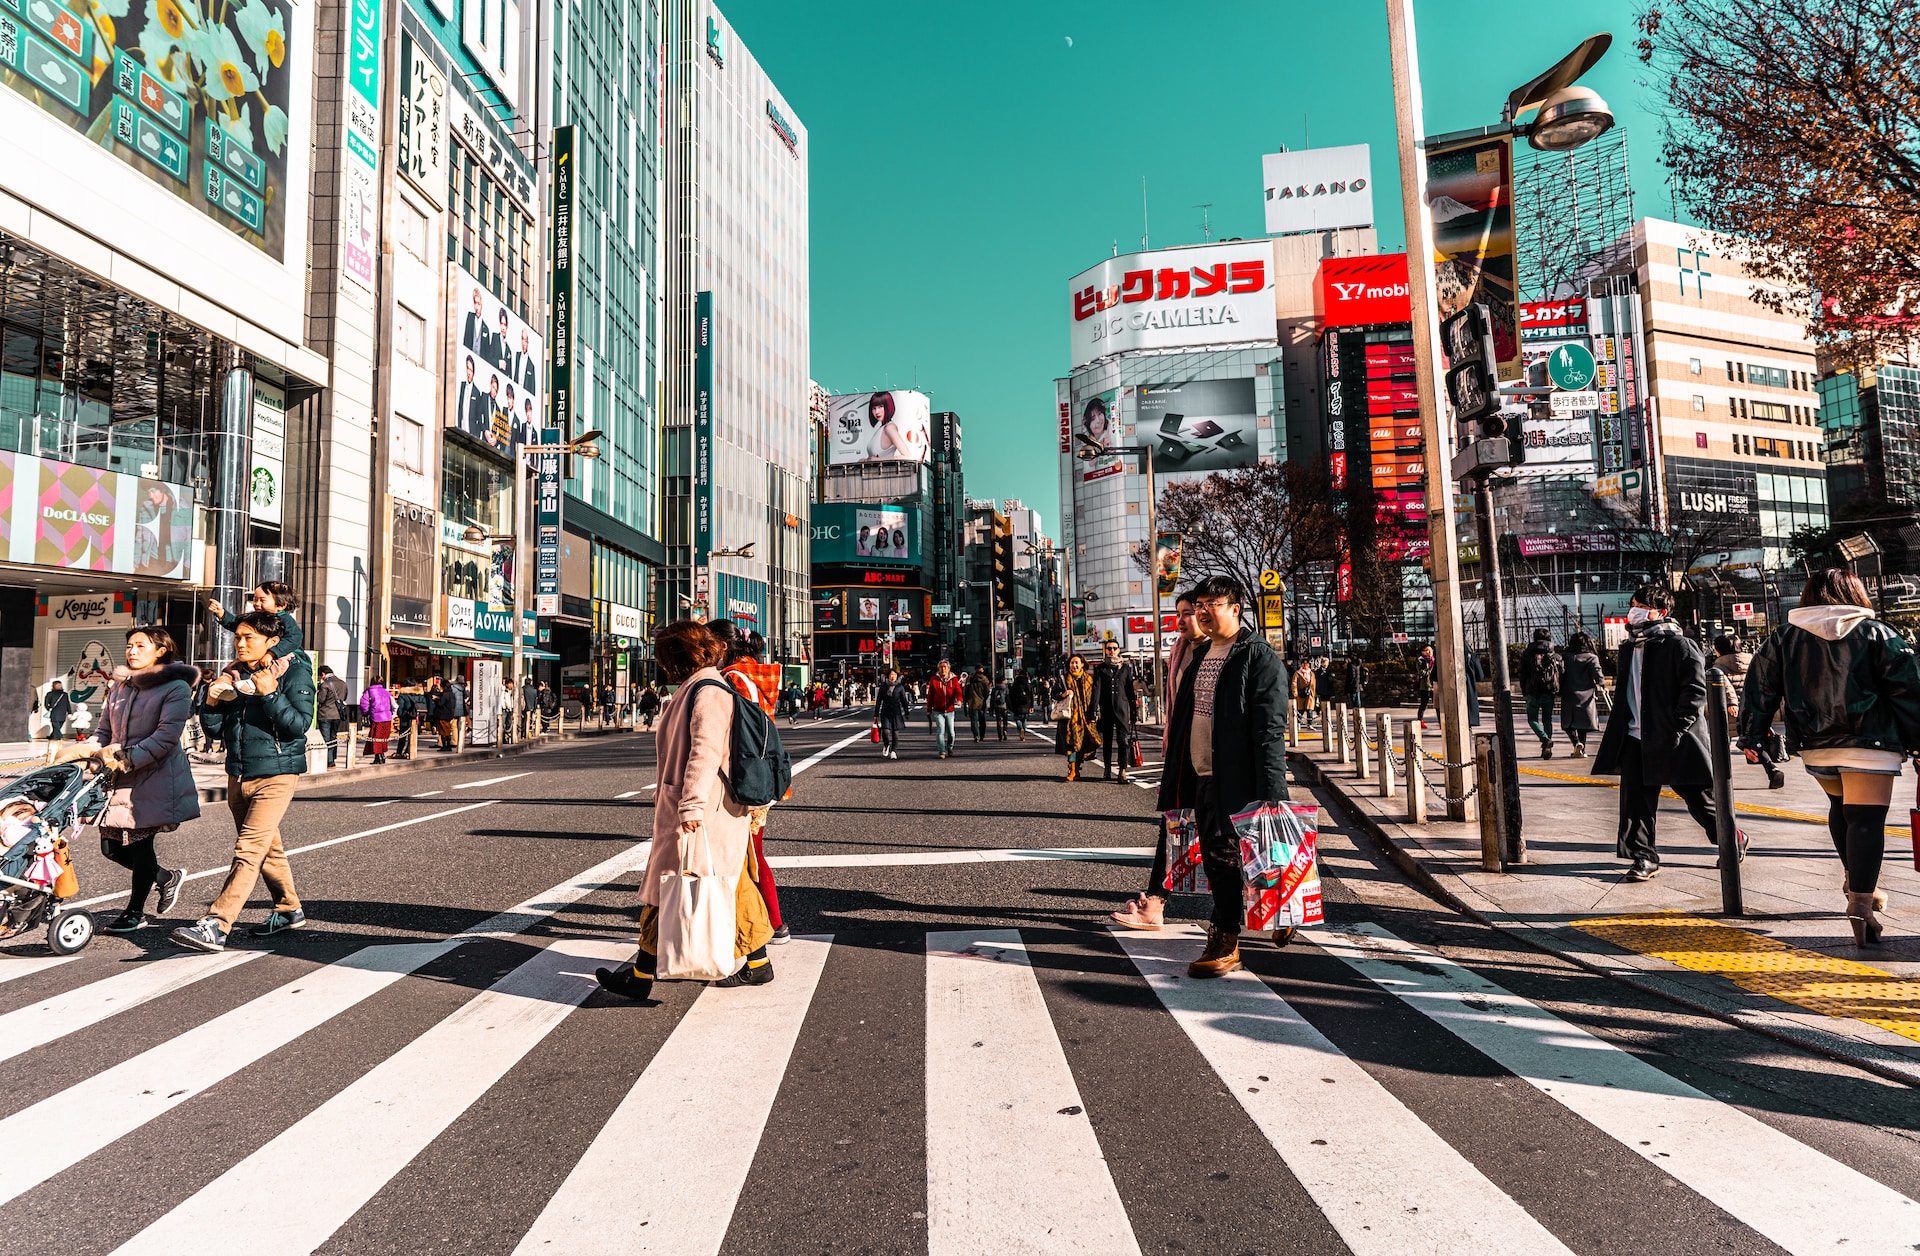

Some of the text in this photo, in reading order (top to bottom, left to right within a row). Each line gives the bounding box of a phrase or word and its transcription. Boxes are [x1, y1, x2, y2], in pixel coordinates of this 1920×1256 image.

[0, 17, 17, 65] 神奈川
[120, 56, 135, 97] 千葉
[118, 102, 134, 143] 山梨
[351, 111, 375, 142] 新宿店
[412, 59, 429, 179] ルノアール
[209, 125, 223, 158] 静岡
[462, 112, 531, 203] 新宿アオキ
[207, 167, 221, 201] 長野
[1264, 178, 1367, 200] TAKANO
[557, 166, 569, 270] SMBC 三井住友銀行
[1073, 260, 1266, 322] ビックカメラ
[1091, 302, 1241, 344] BIC CAMERA
[1552, 395, 1597, 407] 歩行者優先
[838, 416, 862, 432] Spa
[943, 425, 951, 440] SUIT
[1372, 429, 1391, 438] au
[1374, 466, 1393, 475] au
[1621, 471, 1640, 501] P
[1680, 491, 1749, 513] LUSH FRESH
[43, 506, 110, 527] DoCLASSE
[398, 504, 436, 527] AOKI
[1716, 551, 1730, 565] P
[863, 571, 906, 582] ABC-MART
[1264, 571, 1276, 586] 2
[56, 599, 106, 620] Konjac
[728, 598, 758, 615] MIZUHO
[449, 618, 473, 629] ルノアール
[615, 613, 637, 629] GUCCI
[1305, 899, 1322, 909] ビック
[1305, 907, 1322, 917] カメラ
